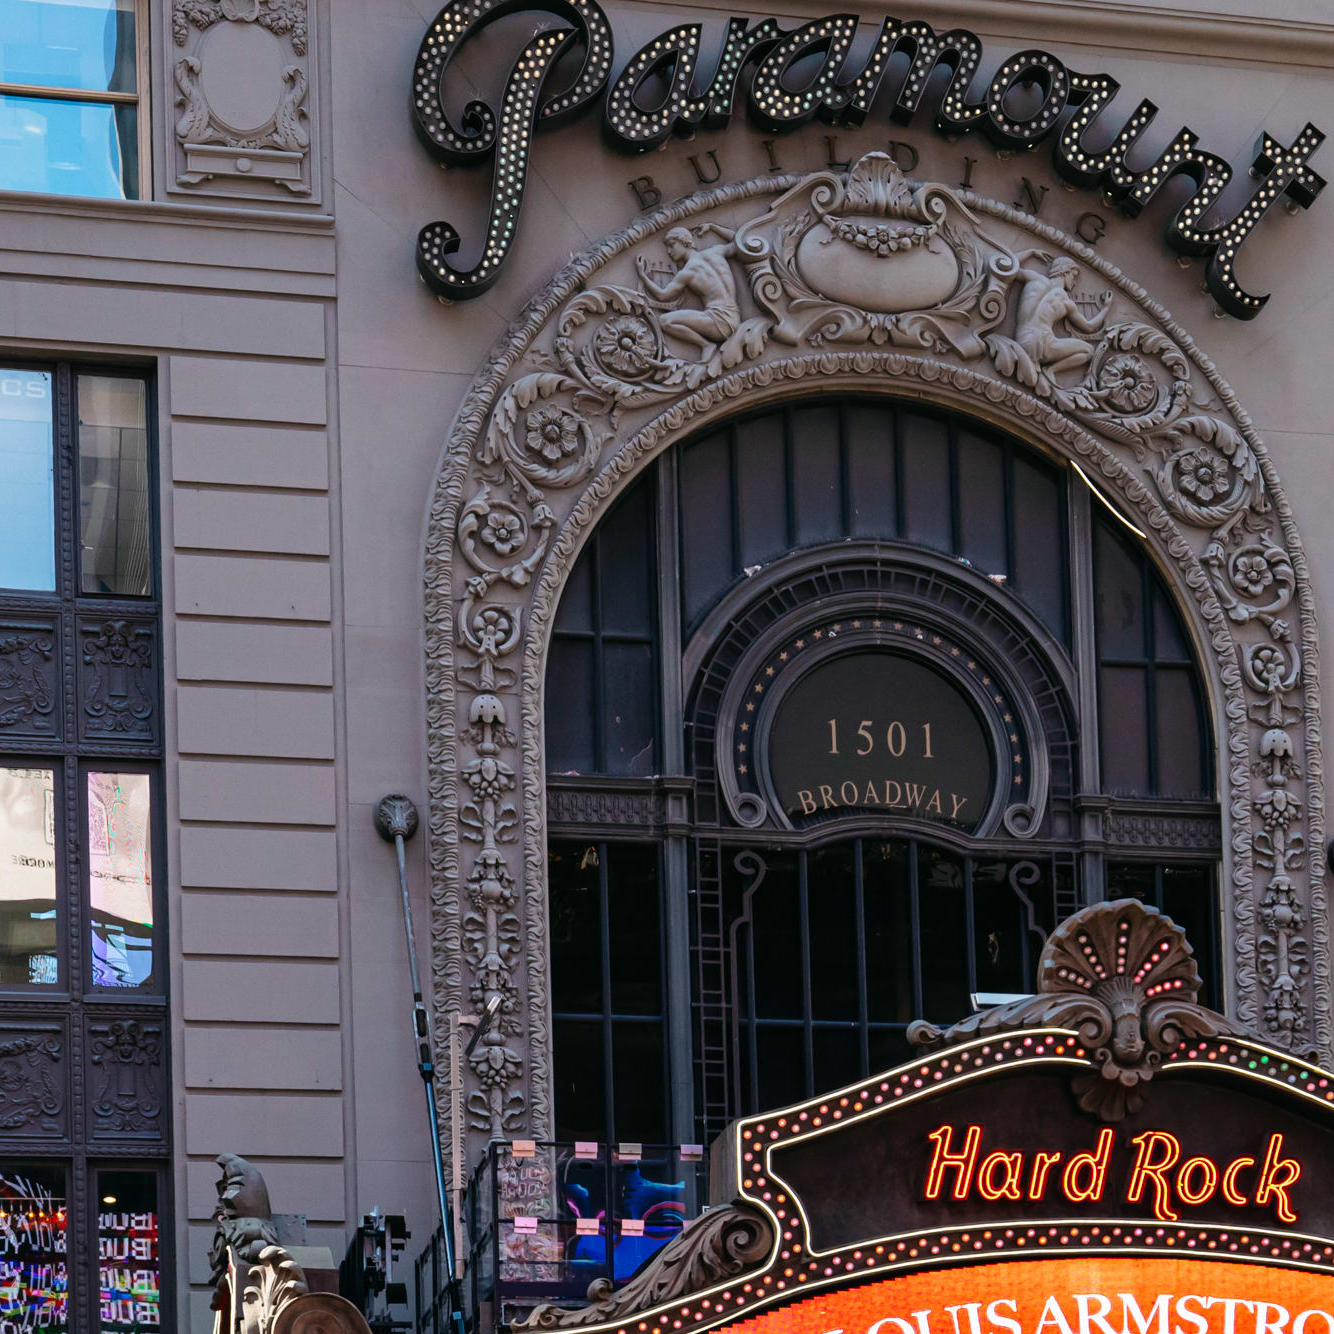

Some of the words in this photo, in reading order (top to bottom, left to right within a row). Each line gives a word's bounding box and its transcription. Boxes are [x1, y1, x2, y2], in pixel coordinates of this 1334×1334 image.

[409, 0, 1327, 320] Paramount
[627, 133, 1107, 246] BUILDING
[828, 719, 934, 758] 1501
[798, 779, 967, 819] BROADWAY
[926, 1125, 1114, 1201] Hard
[1128, 1131, 1301, 1222] Rock
